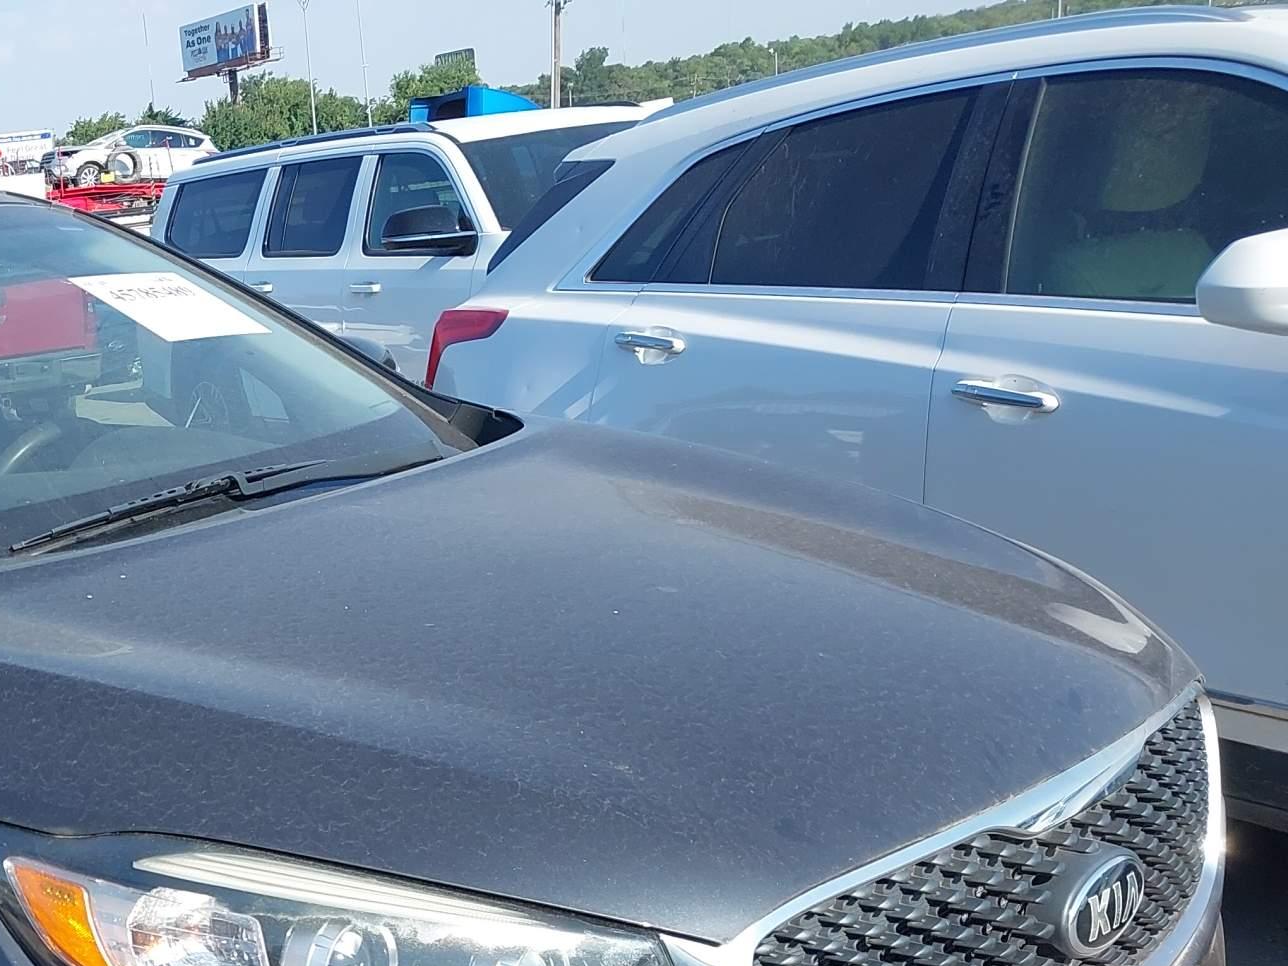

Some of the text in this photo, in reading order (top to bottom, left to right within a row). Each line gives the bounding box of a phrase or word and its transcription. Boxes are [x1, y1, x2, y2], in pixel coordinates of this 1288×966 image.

[184, 24, 210, 37] Together
[186, 35, 211, 48] As One
[1088, 871, 1139, 942] KIA
